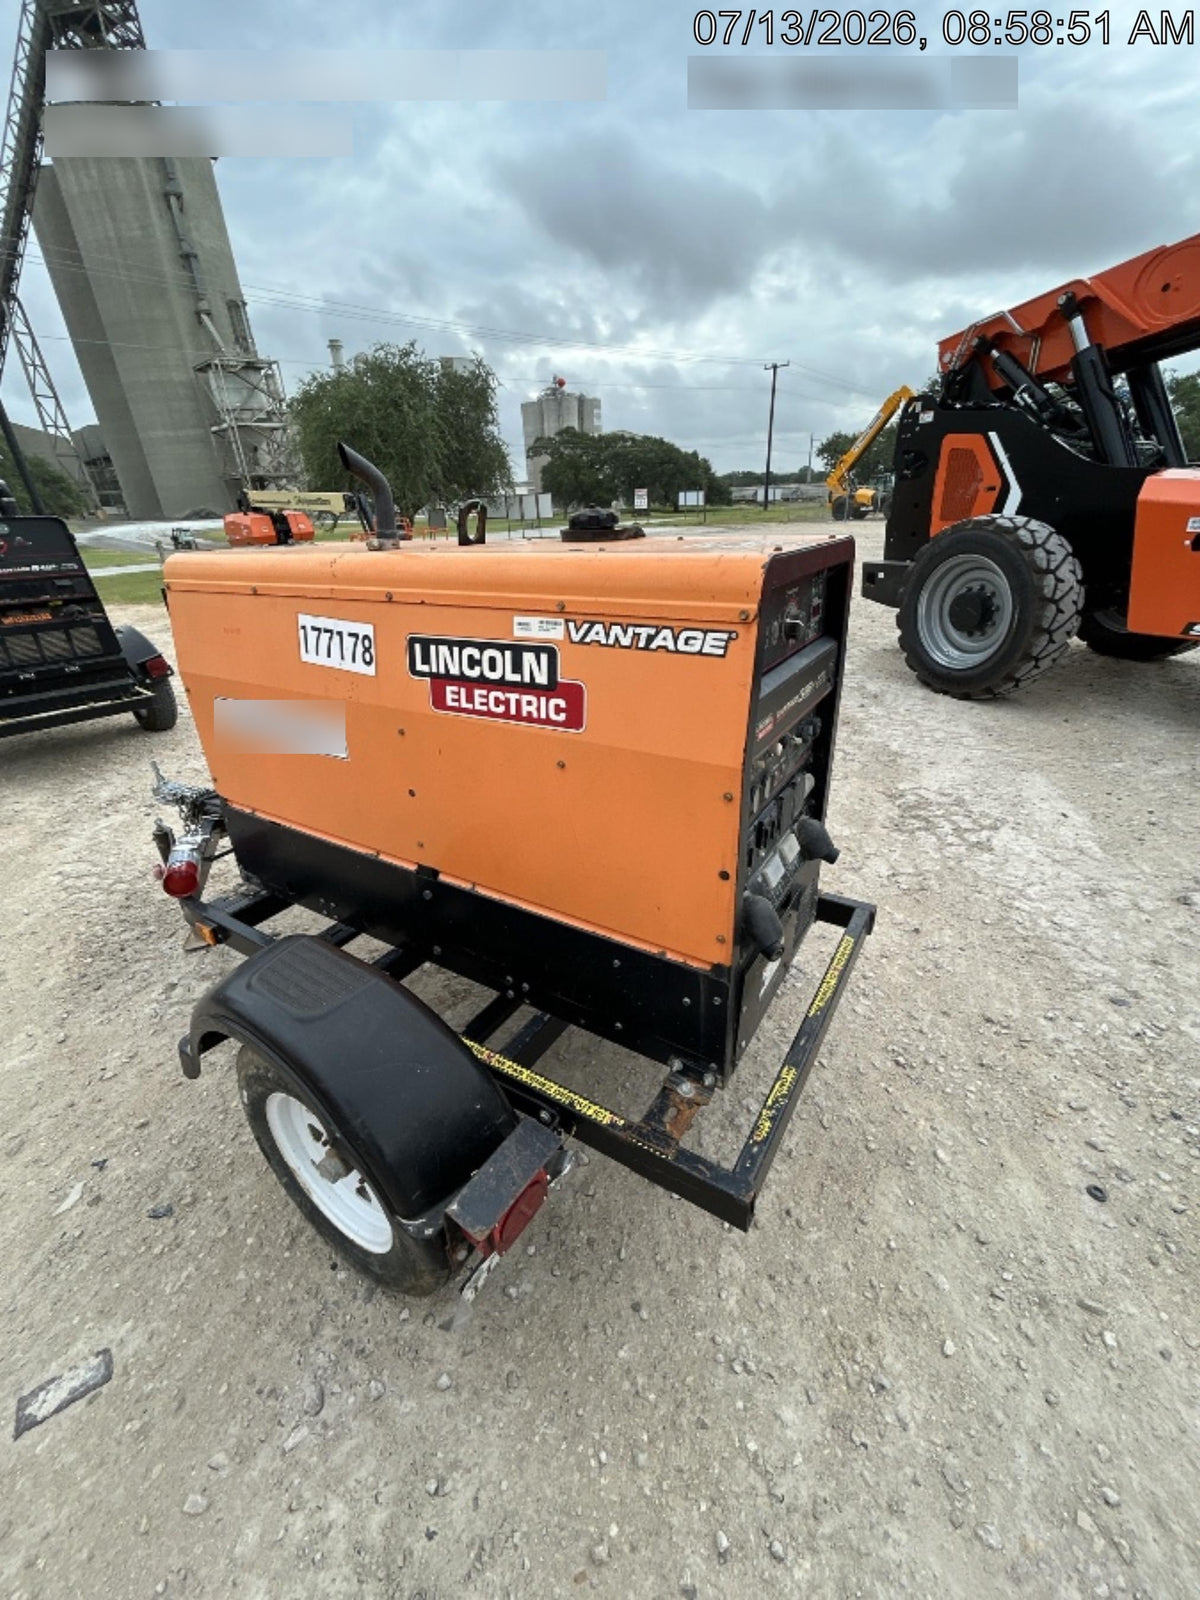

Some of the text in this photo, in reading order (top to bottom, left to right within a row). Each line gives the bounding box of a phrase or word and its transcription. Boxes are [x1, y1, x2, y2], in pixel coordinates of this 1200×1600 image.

[300, 625, 374, 667] 177178
[566, 620, 733, 657] VANTAGE
[414, 643, 549, 685] LINCOLN
[445, 685, 567, 722] ELECTRIC
